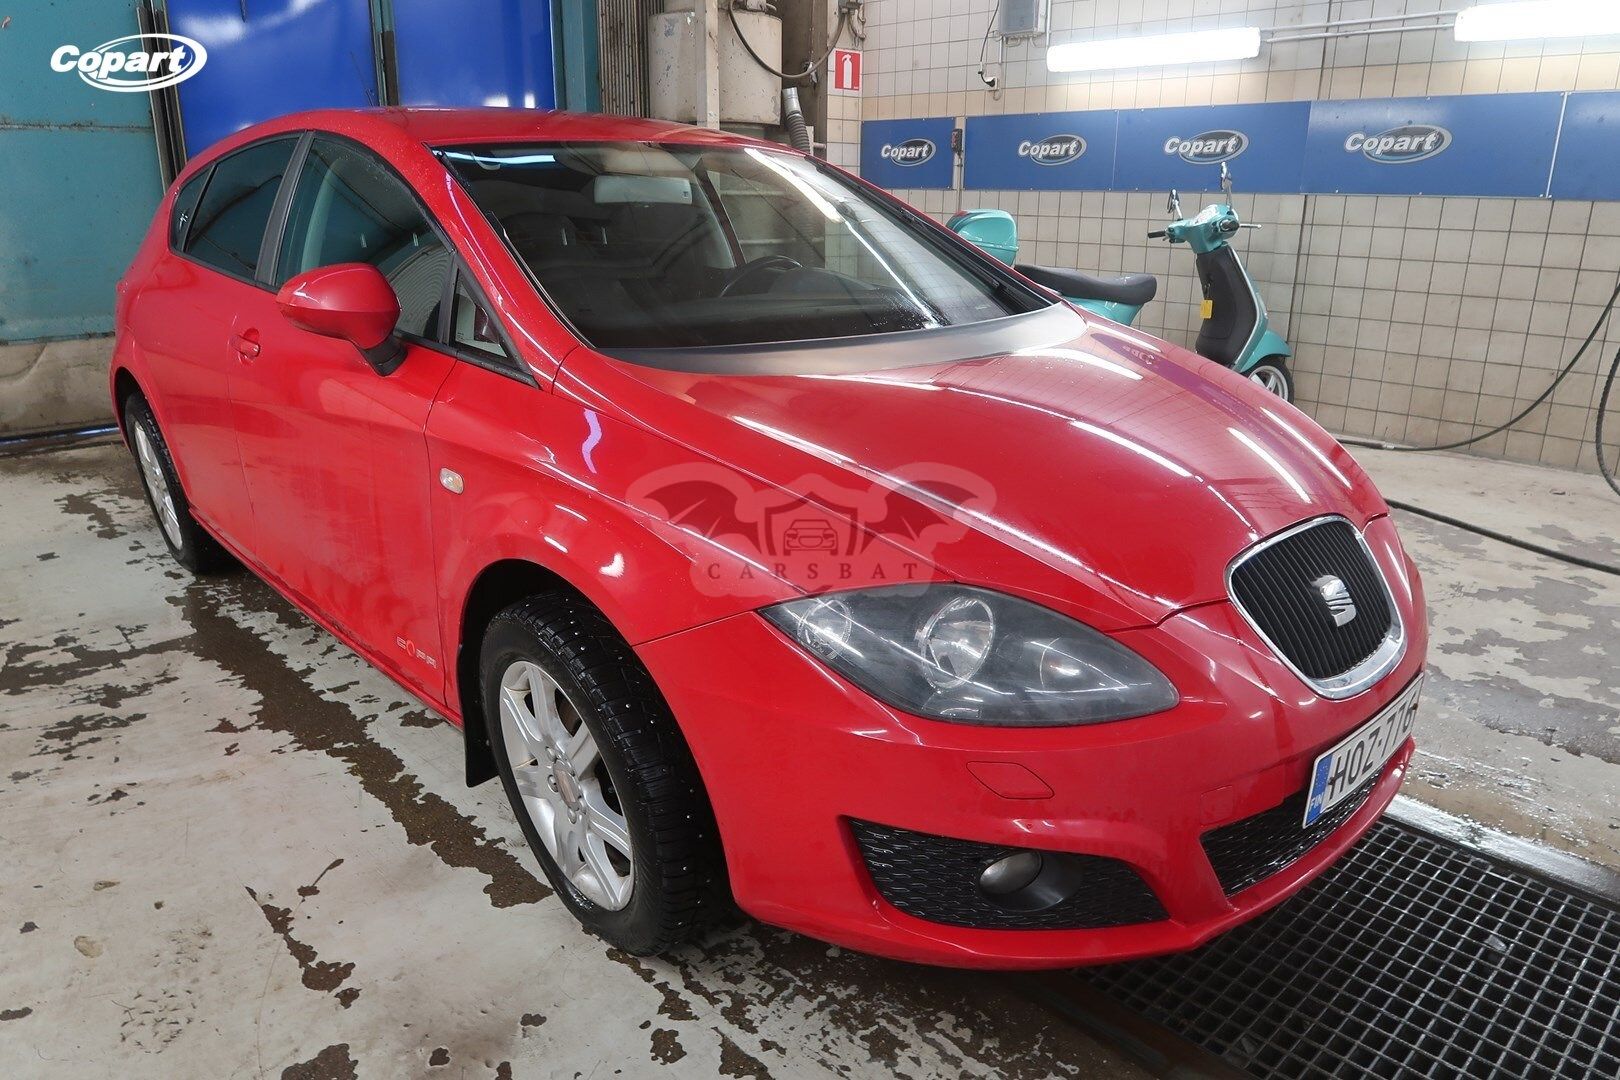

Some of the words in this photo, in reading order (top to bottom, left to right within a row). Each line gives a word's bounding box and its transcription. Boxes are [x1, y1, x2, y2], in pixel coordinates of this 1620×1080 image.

[880, 143, 930, 161] Copart
[1017, 140, 1078, 159] Copart
[1163, 135, 1238, 157] Copart
[1343, 130, 1439, 156] Copart
[1328, 690, 1417, 800] HOZ-776
